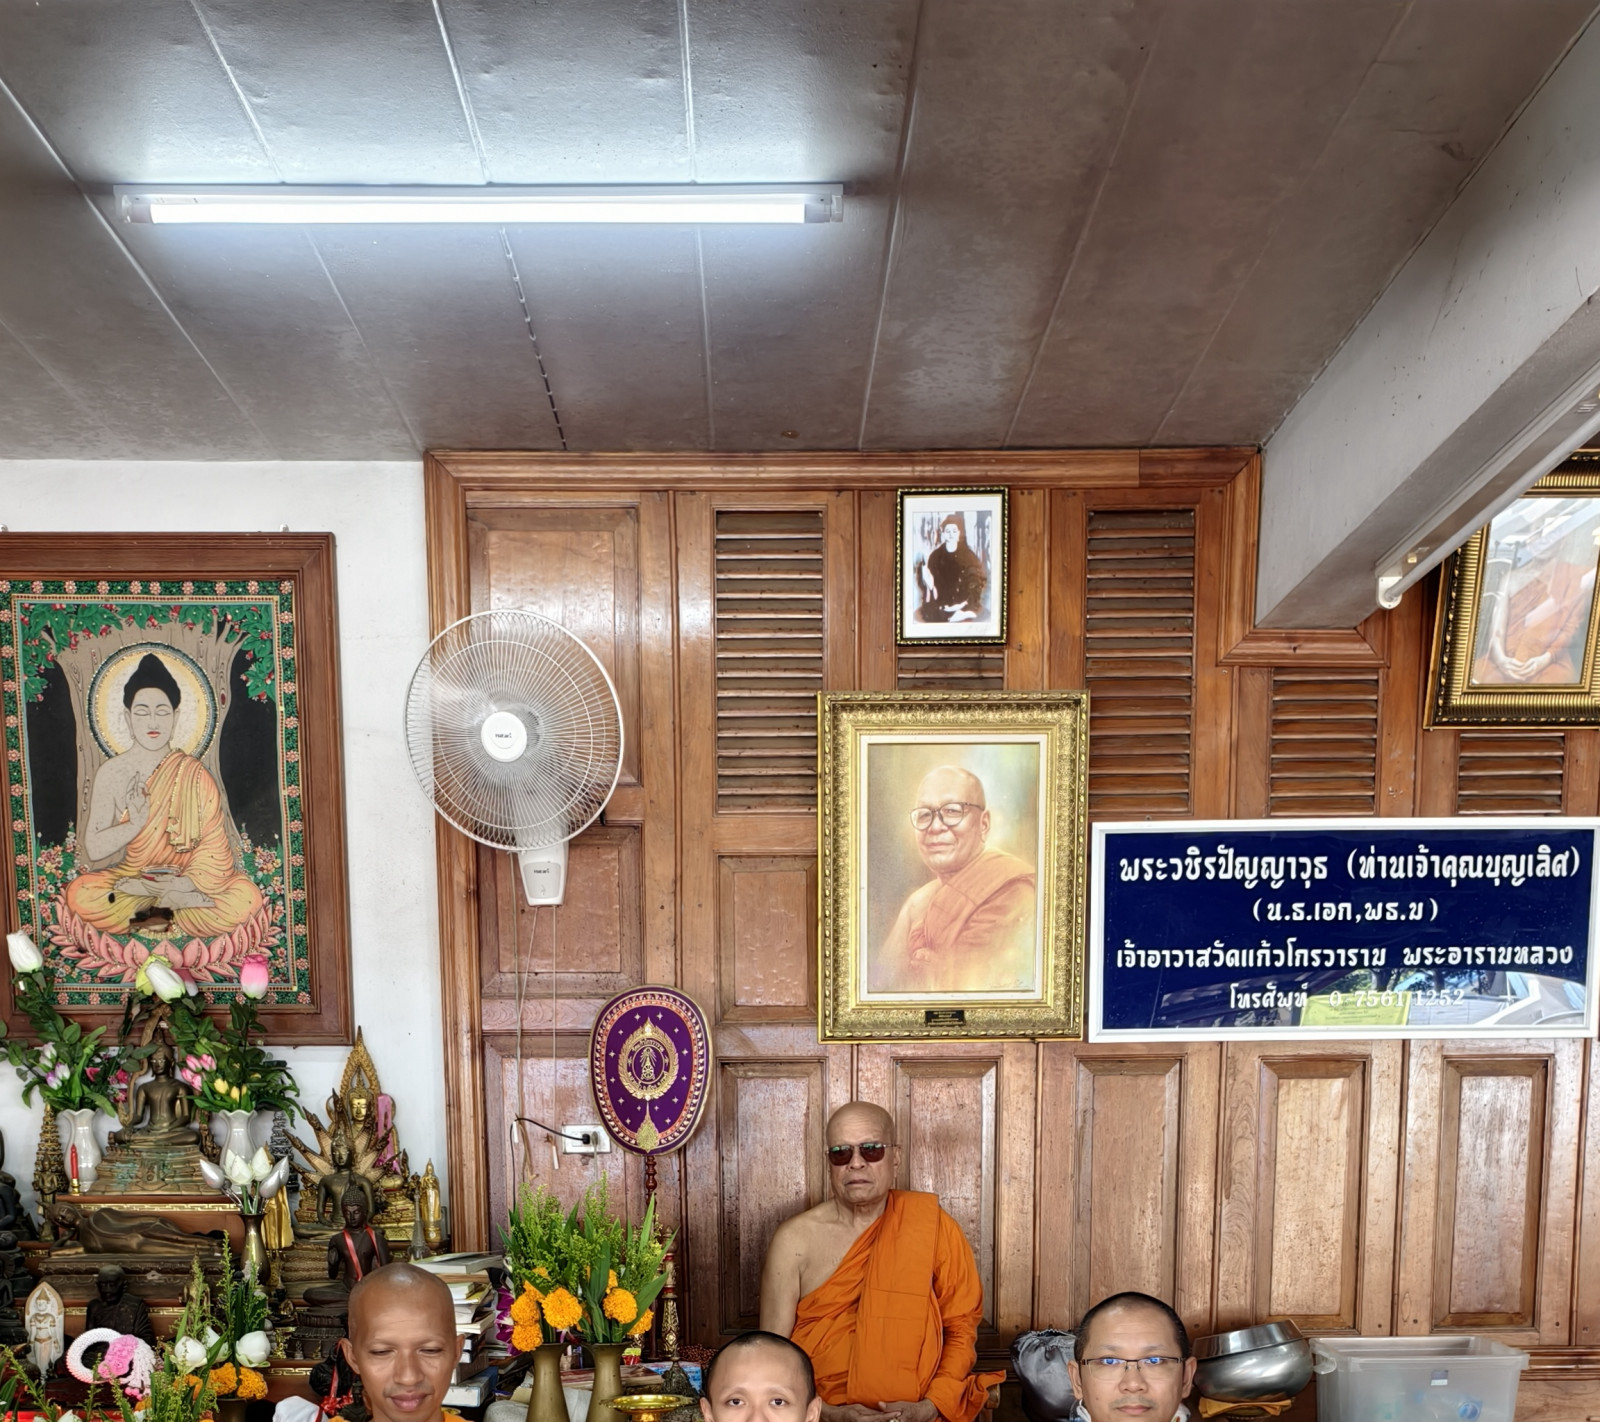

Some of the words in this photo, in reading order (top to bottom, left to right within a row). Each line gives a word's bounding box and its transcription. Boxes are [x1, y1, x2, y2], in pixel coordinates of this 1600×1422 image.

[1119, 844, 1328, 889] พระวชิรปัญญาวุธ
[1346, 843, 1580, 888] (ท่านเจ้าคุณบุญเลิศ)
[1116, 936, 1386, 968] เจ้าอาวาสวัดแก้วโกรวาราม
[1403, 945, 1574, 966] พระอารามหลวง
[1229, 982, 1309, 1011] โทรศัพท์
